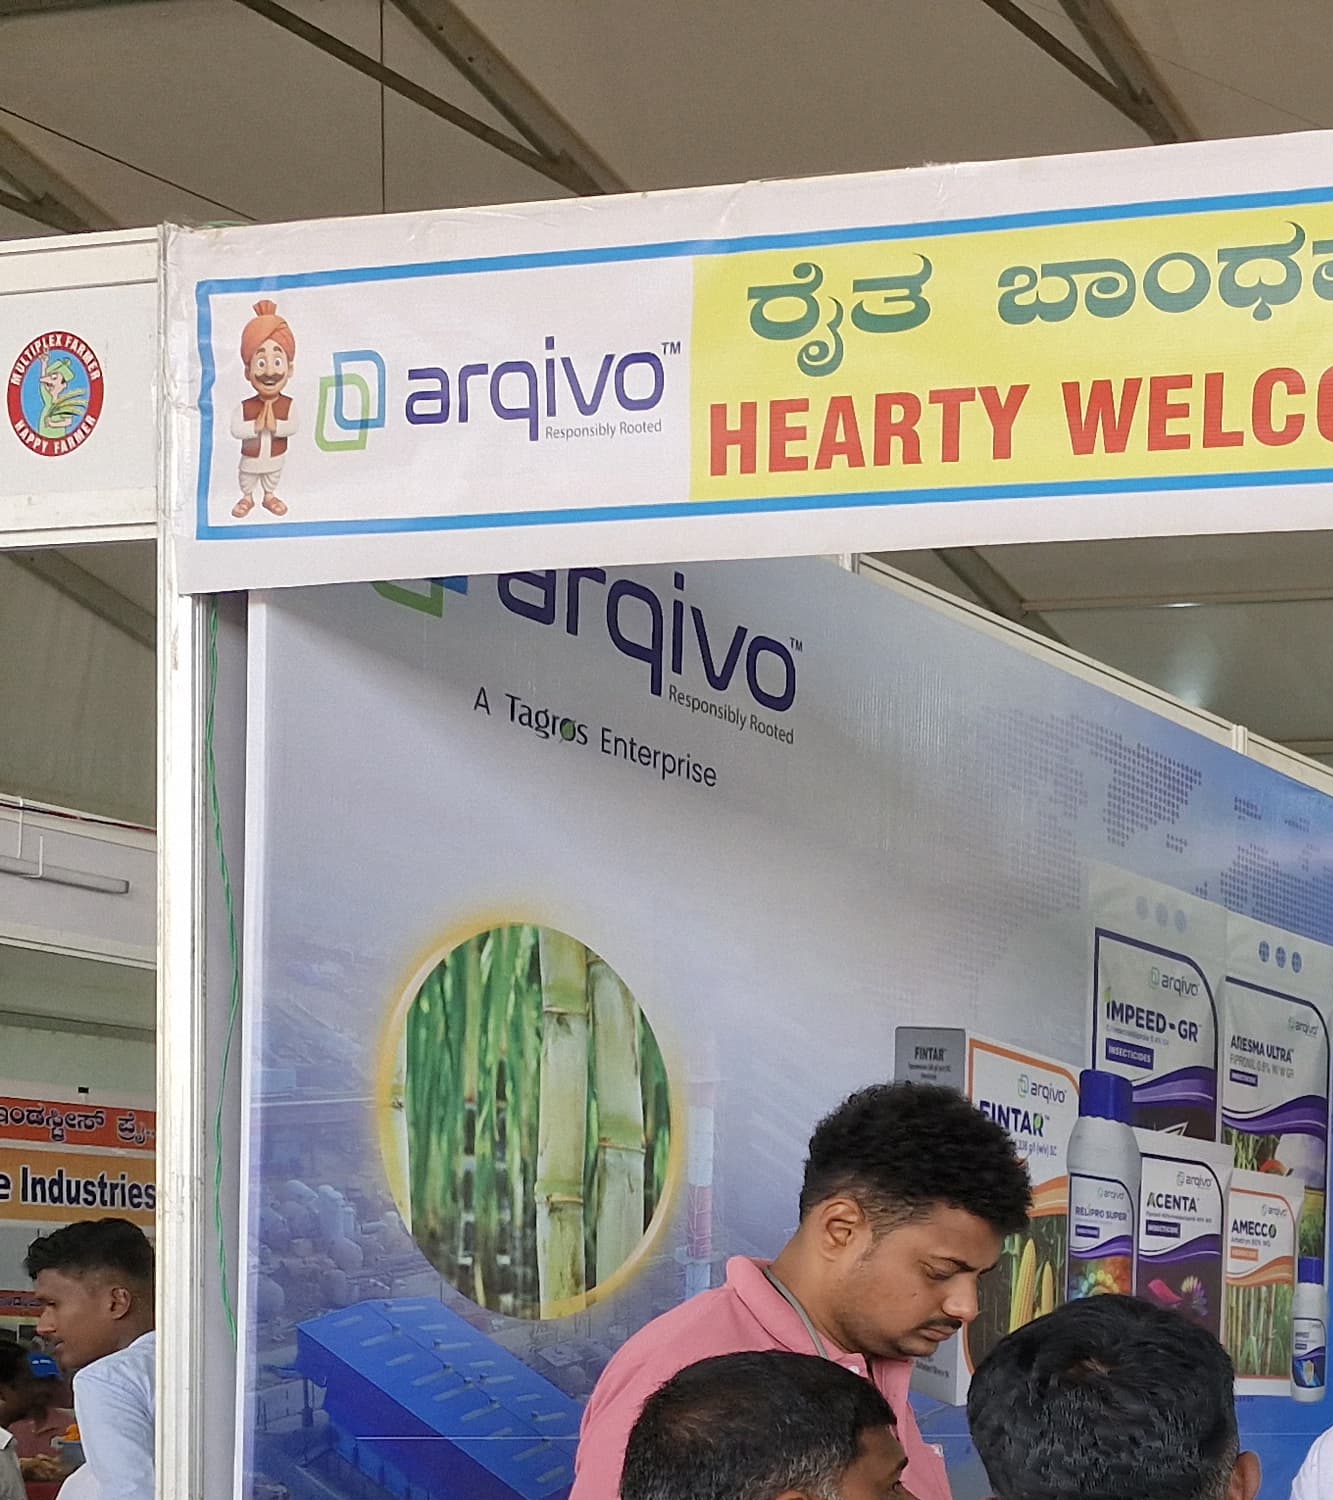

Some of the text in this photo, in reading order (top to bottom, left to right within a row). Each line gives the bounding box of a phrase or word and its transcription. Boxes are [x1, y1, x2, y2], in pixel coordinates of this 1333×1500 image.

[747, 253, 932, 377] ರೈತ
[11, 334, 100, 386] MULTIPLEX FARMER
[405, 336, 665, 441] arqivo
[13, 416, 96, 454] HAPPY FARMER
[545, 418, 663, 441] Responsibly Rooted
[708, 383, 1030, 476] HEARTY
[497, 567, 797, 712] arqivo
[473, 686, 718, 788] A Tagros Enterprise
[668, 684, 794, 746] Responsibly Rooted
[914, 1046, 945, 1062] FINTAR
[21, 1167, 156, 1210] Industries
[1147, 1192, 1197, 1212] ACENTA
[1231, 1219, 1277, 1239] AMECCO
